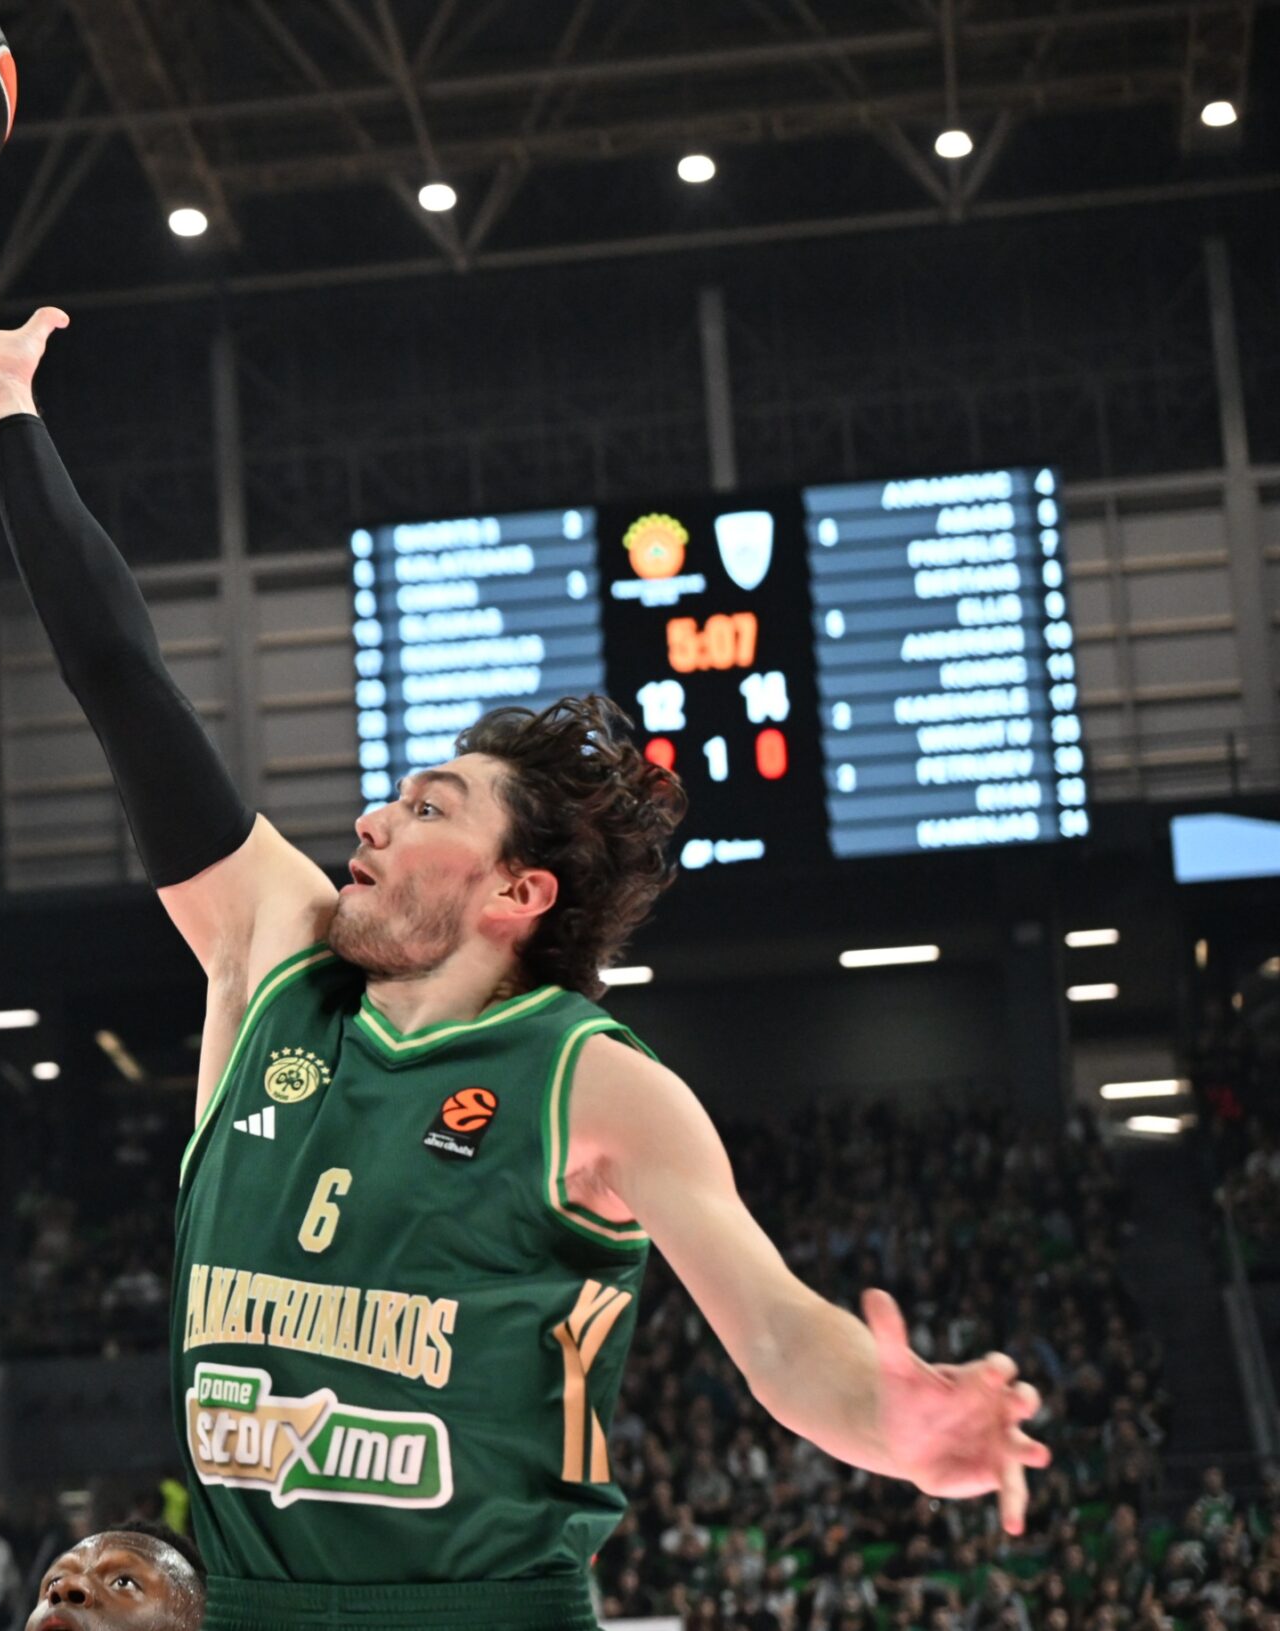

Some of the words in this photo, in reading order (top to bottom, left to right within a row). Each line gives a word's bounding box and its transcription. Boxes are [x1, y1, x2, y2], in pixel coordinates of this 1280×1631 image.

[666, 612, 758, 672] 5:07
[636, 680, 686, 732] 12
[703, 736, 728, 782] 1
[297, 1167, 353, 1253] 6
[199, 1376, 253, 1405] pame
